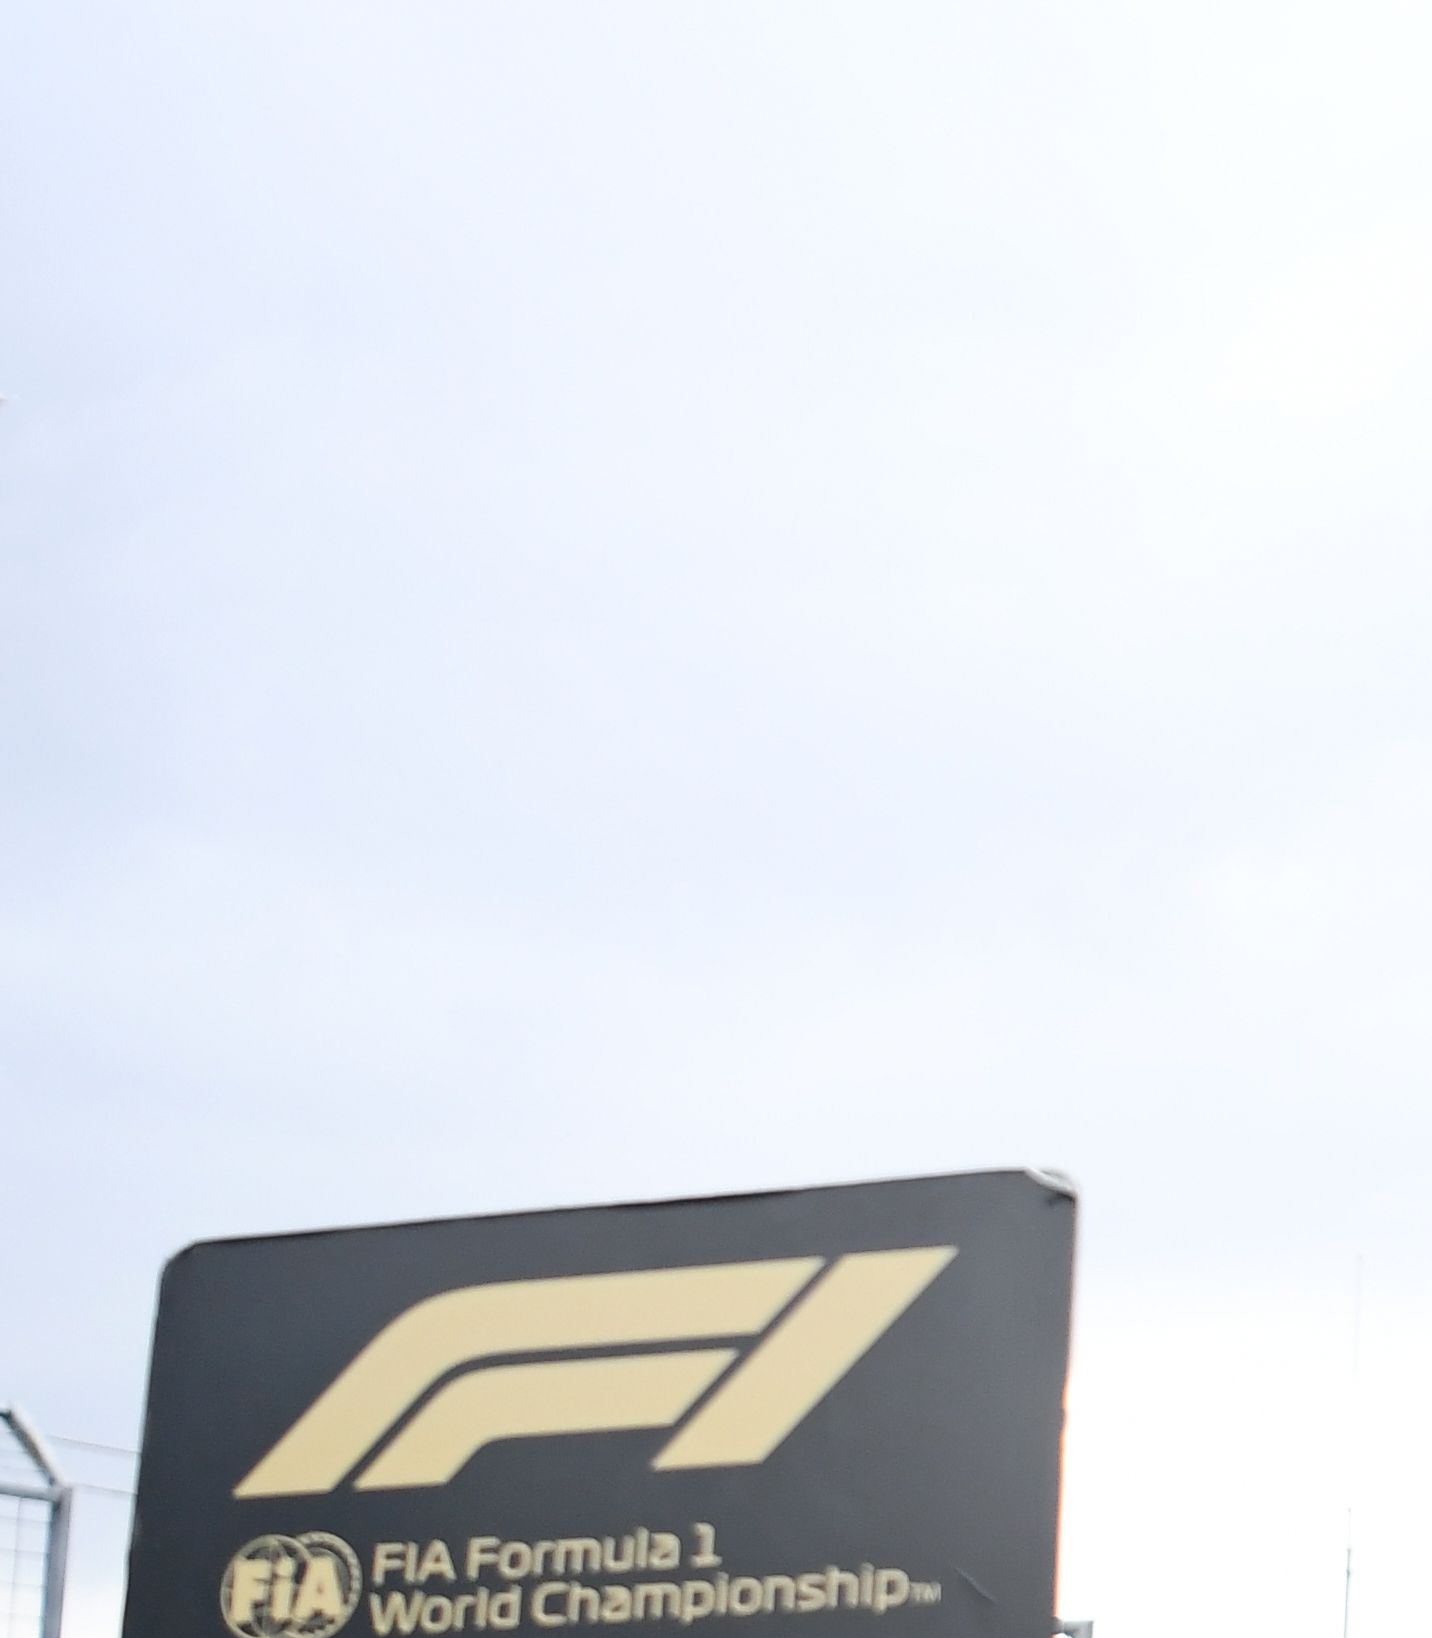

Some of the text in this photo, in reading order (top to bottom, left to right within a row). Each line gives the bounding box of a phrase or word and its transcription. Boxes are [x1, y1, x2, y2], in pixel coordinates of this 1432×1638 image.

[371, 1521, 723, 1587] FIA Formula 1
[368, 1583, 523, 1638] World
